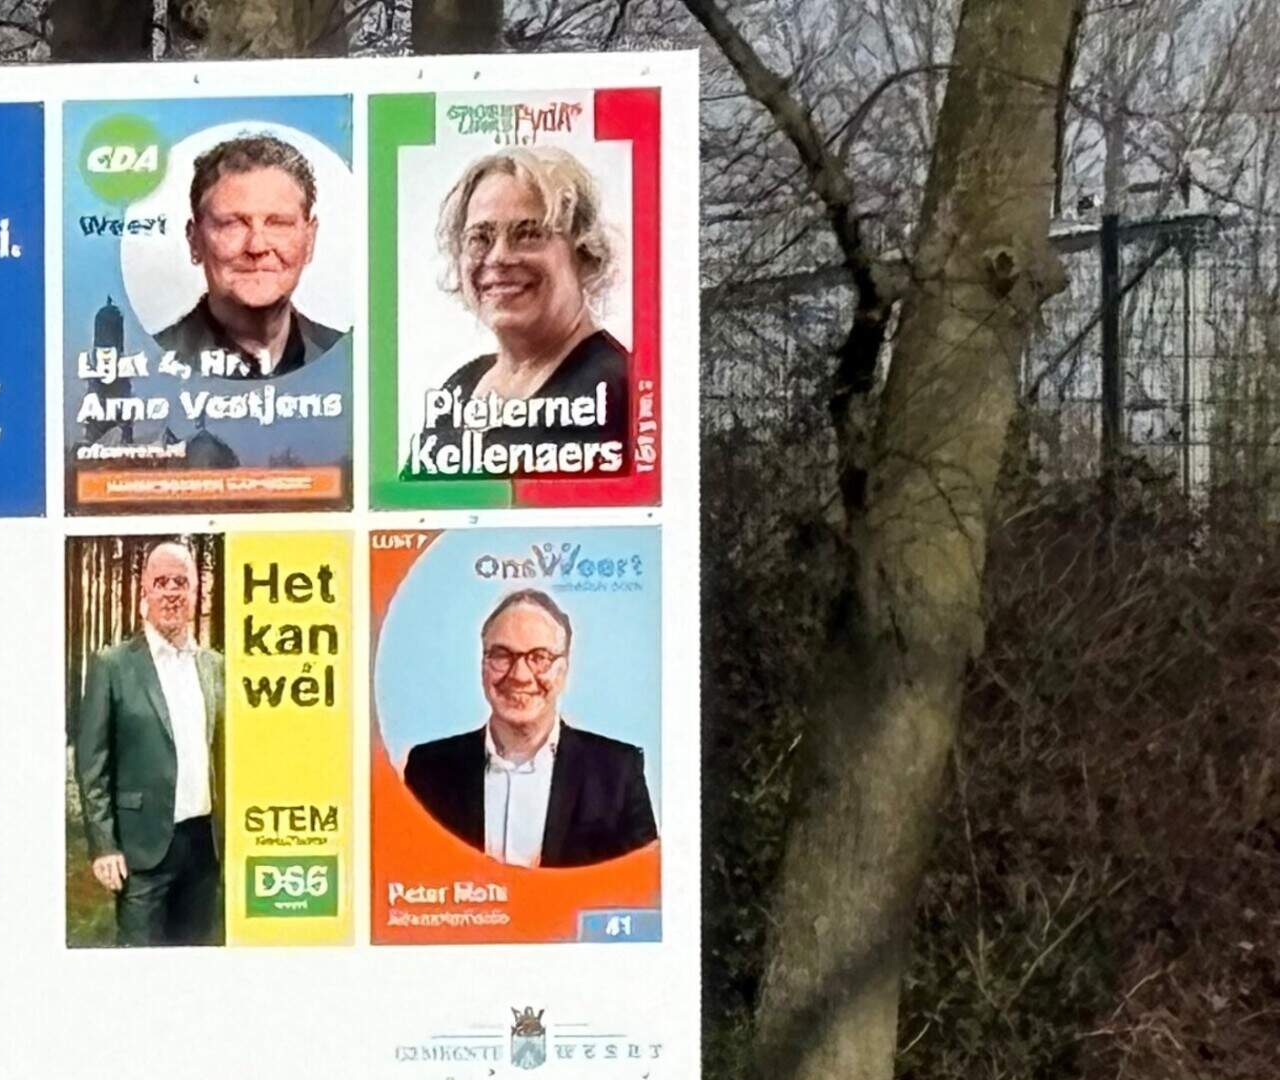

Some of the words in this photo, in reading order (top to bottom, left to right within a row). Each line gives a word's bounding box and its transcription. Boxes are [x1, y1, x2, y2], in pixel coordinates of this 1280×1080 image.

[87, 145, 158, 173] CDA
[76, 392, 170, 423] Arno
[424, 381, 608, 428] Pieternel
[410, 431, 624, 475] Kellenaers
[243, 563, 335, 604] Het
[243, 616, 338, 656] kan
[244, 805, 338, 832] STEM
